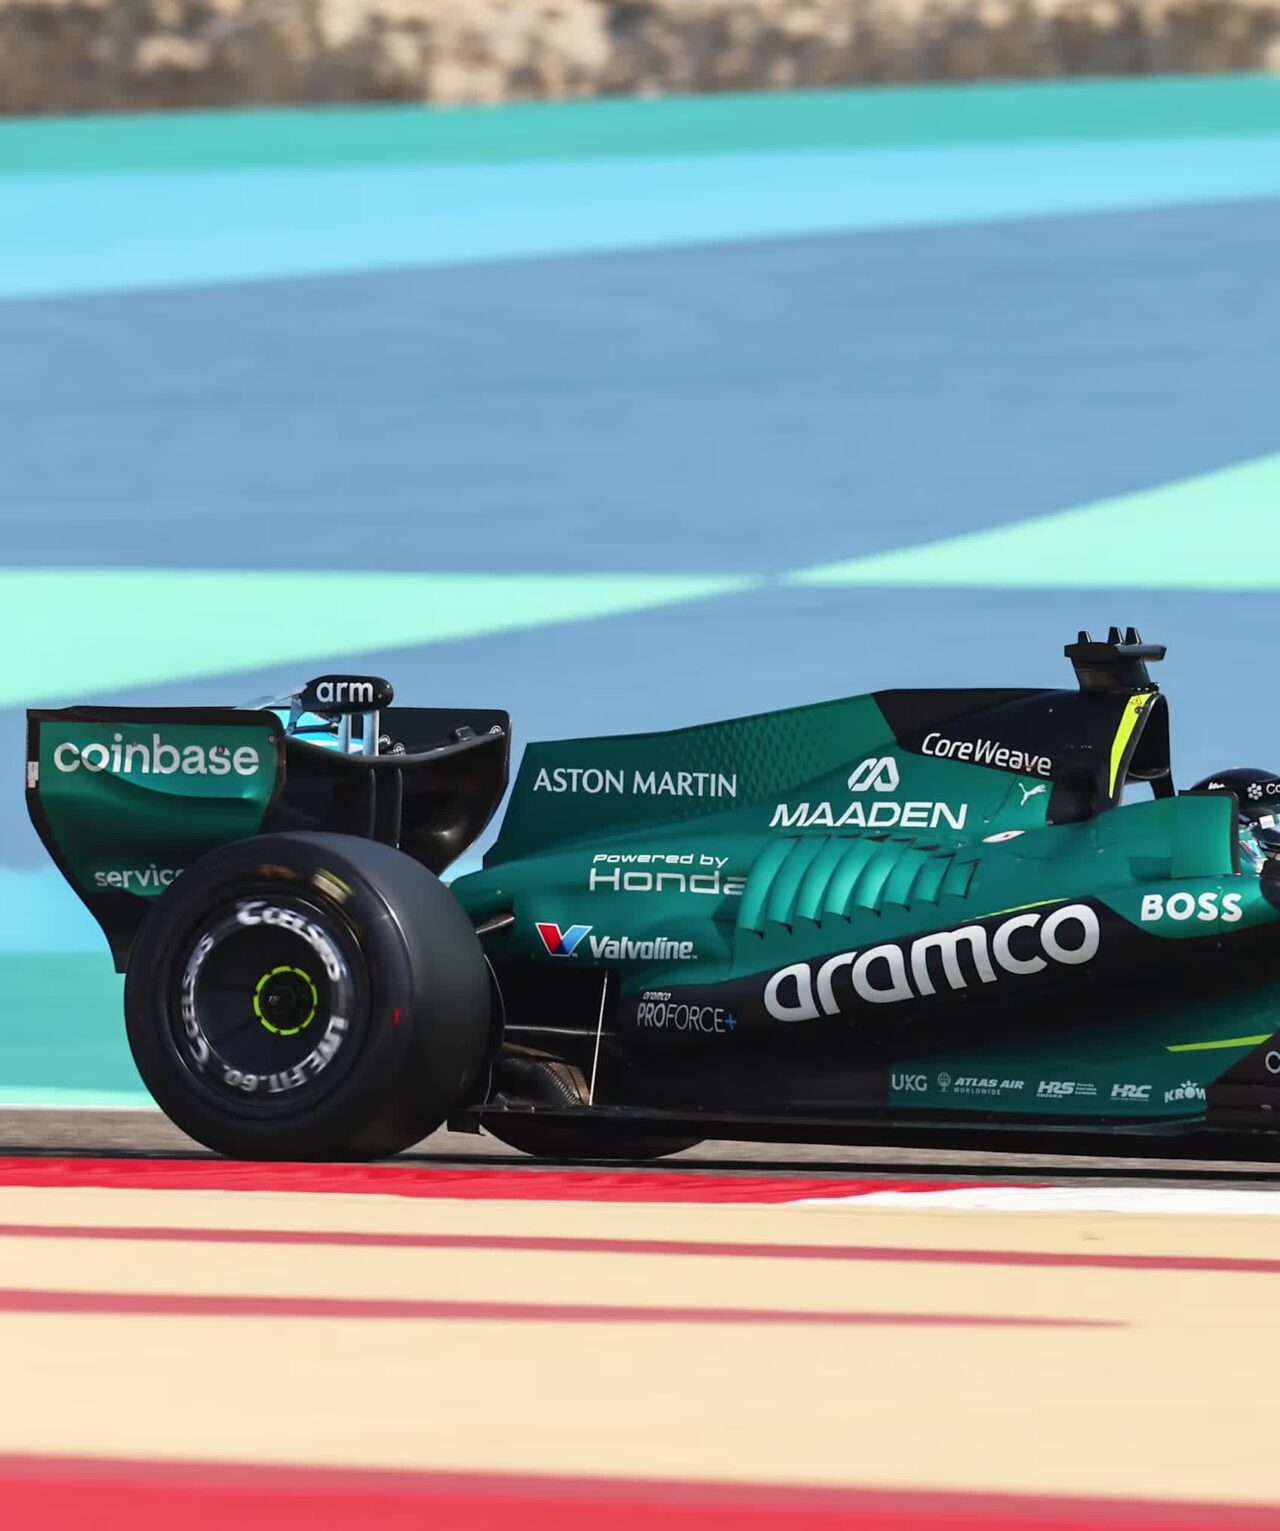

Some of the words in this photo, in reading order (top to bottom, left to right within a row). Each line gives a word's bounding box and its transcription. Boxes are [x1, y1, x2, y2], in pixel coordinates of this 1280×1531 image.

[316, 680, 374, 703] arm
[53, 733, 259, 776] coinbase
[921, 732, 1052, 776] CoreWeave
[533, 767, 625, 794] ASTON
[633, 771, 737, 797] MARTIN
[769, 801, 967, 830] MAADEN
[593, 853, 693, 864] Powered
[700, 854, 729, 868] by
[94, 863, 185, 888] servic
[1140, 892, 1243, 922] BOSS
[589, 935, 694, 959] Valvoline
[763, 904, 1100, 1023] aramco
[642, 991, 671, 1001] aramco
[891, 1074, 928, 1091] UKG
[954, 1077, 998, 1088] ATLAS
[999, 1079, 1025, 1090] AIR
[954, 1087, 1001, 1096] WORLDWIDE
[1037, 1081, 1076, 1095] HRS
[1111, 1083, 1152, 1098] HRC
